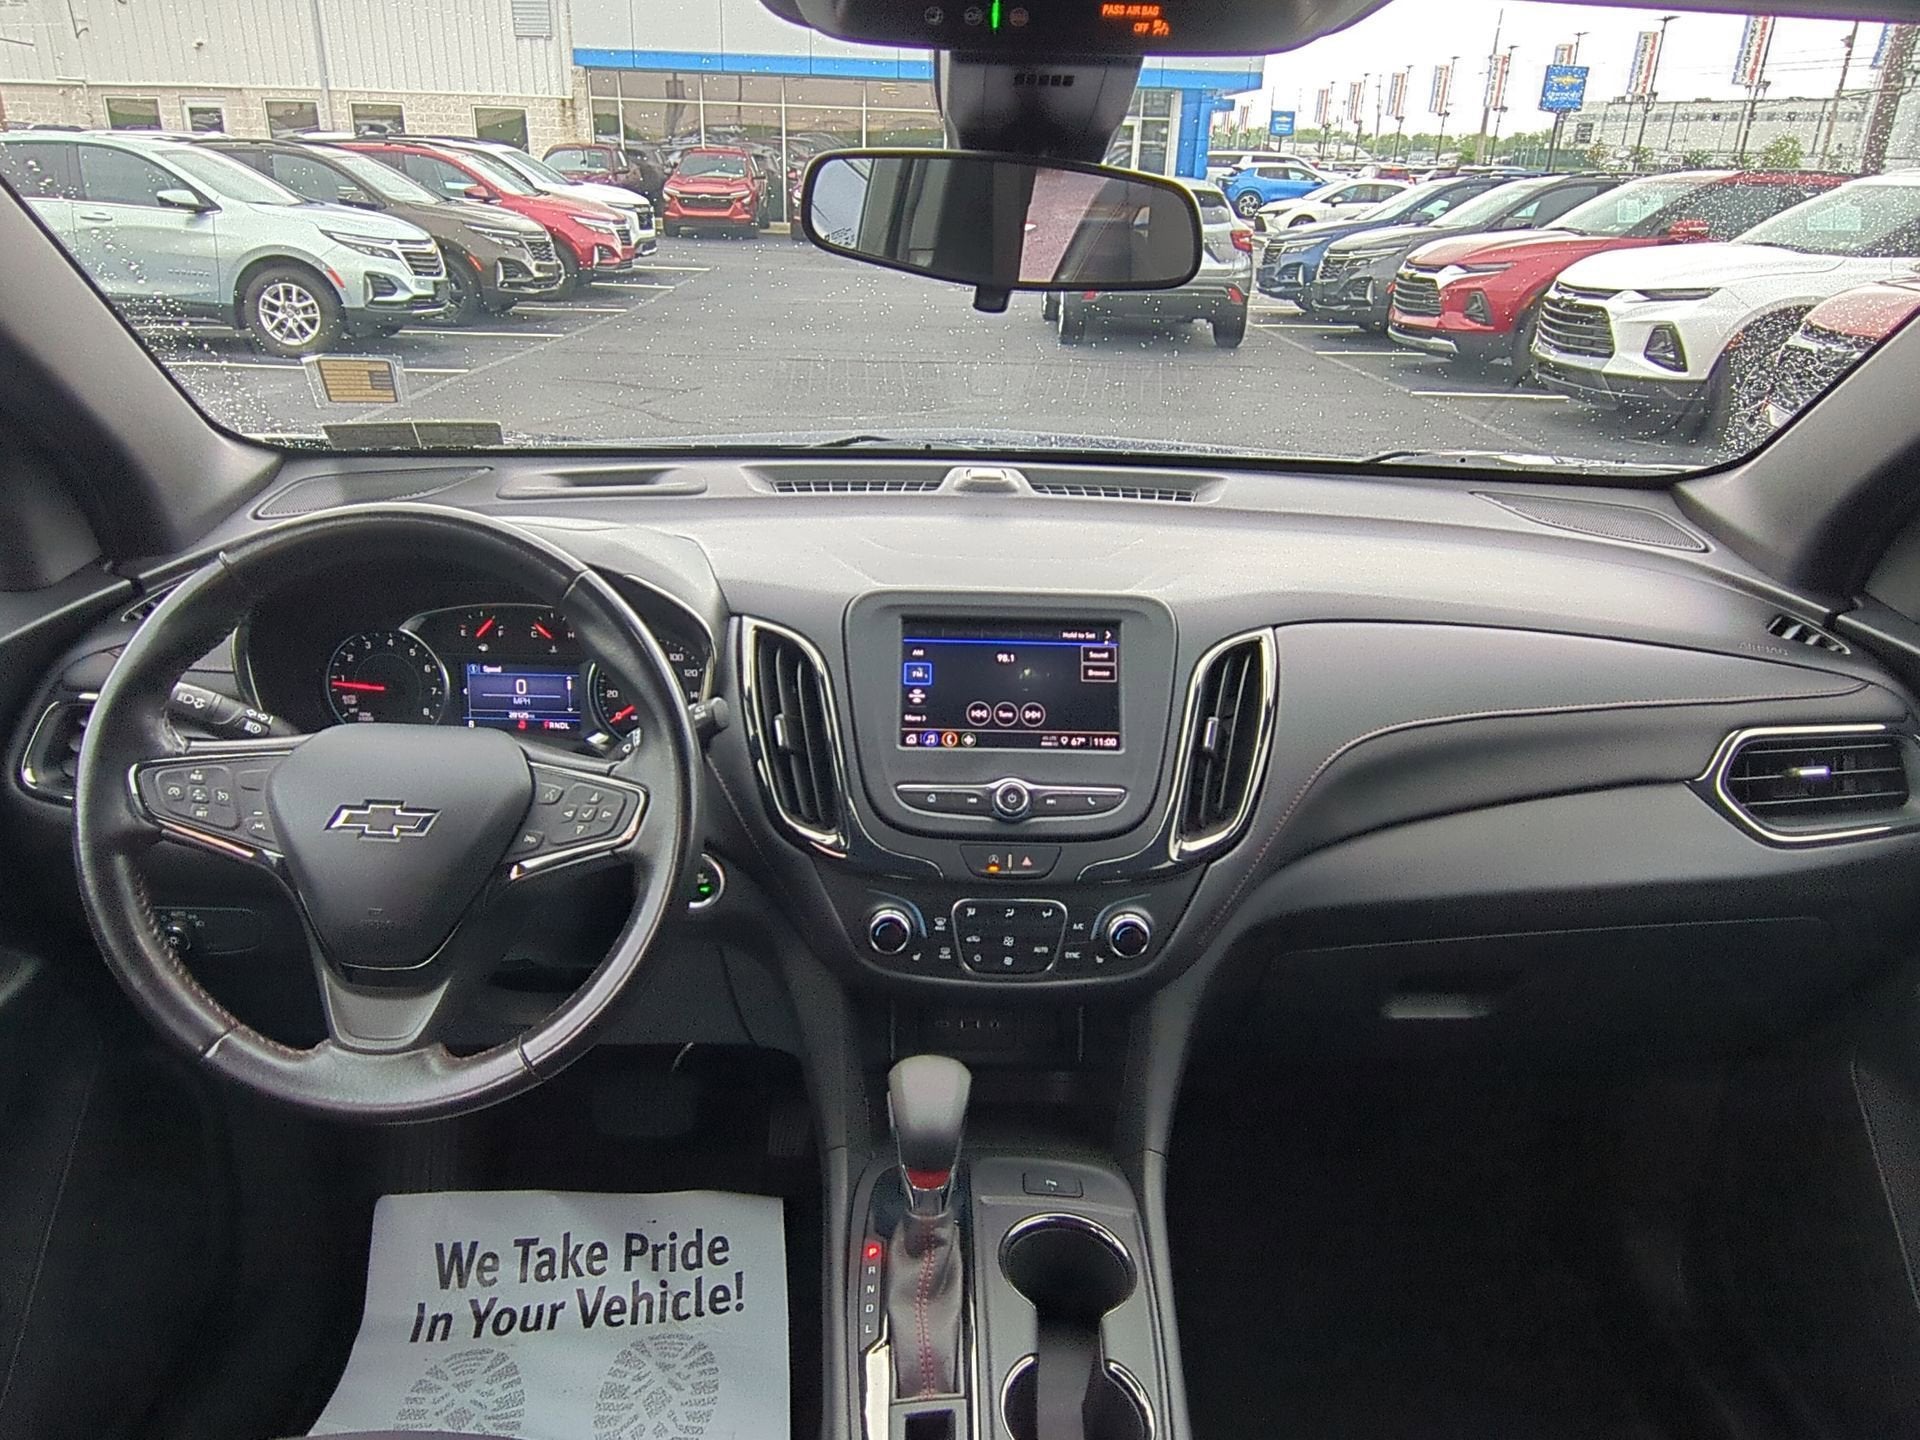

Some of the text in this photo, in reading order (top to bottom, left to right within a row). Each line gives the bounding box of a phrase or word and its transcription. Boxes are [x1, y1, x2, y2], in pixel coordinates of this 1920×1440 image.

[1102, 4, 1160, 16] PASS AIR BAG
[1134, 22, 1150, 33] OFF
[460, 629, 467, 637] E
[567, 631, 575, 639] H
[365, 641, 371, 650] 3
[387, 639, 394, 647] 4
[409, 648, 416, 657] 5
[347, 654, 354, 662] 2
[669, 652, 684, 662] 100
[424, 665, 431, 673] 6
[684, 669, 698, 677] 120
[431, 687, 437, 695] 7
[515, 679, 527, 695] 0
[606, 690, 618, 698] 20
[1094, 738, 1117, 748] 11:00
[868, 1248, 877, 1257] P
[435, 1229, 729, 1290] We Take Pride
[868, 1266, 876, 1274] R
[866, 1285, 875, 1293] N
[410, 1272, 746, 1343] In Your Vehicle!
[865, 1304, 874, 1313] D
[865, 1325, 872, 1333] L
